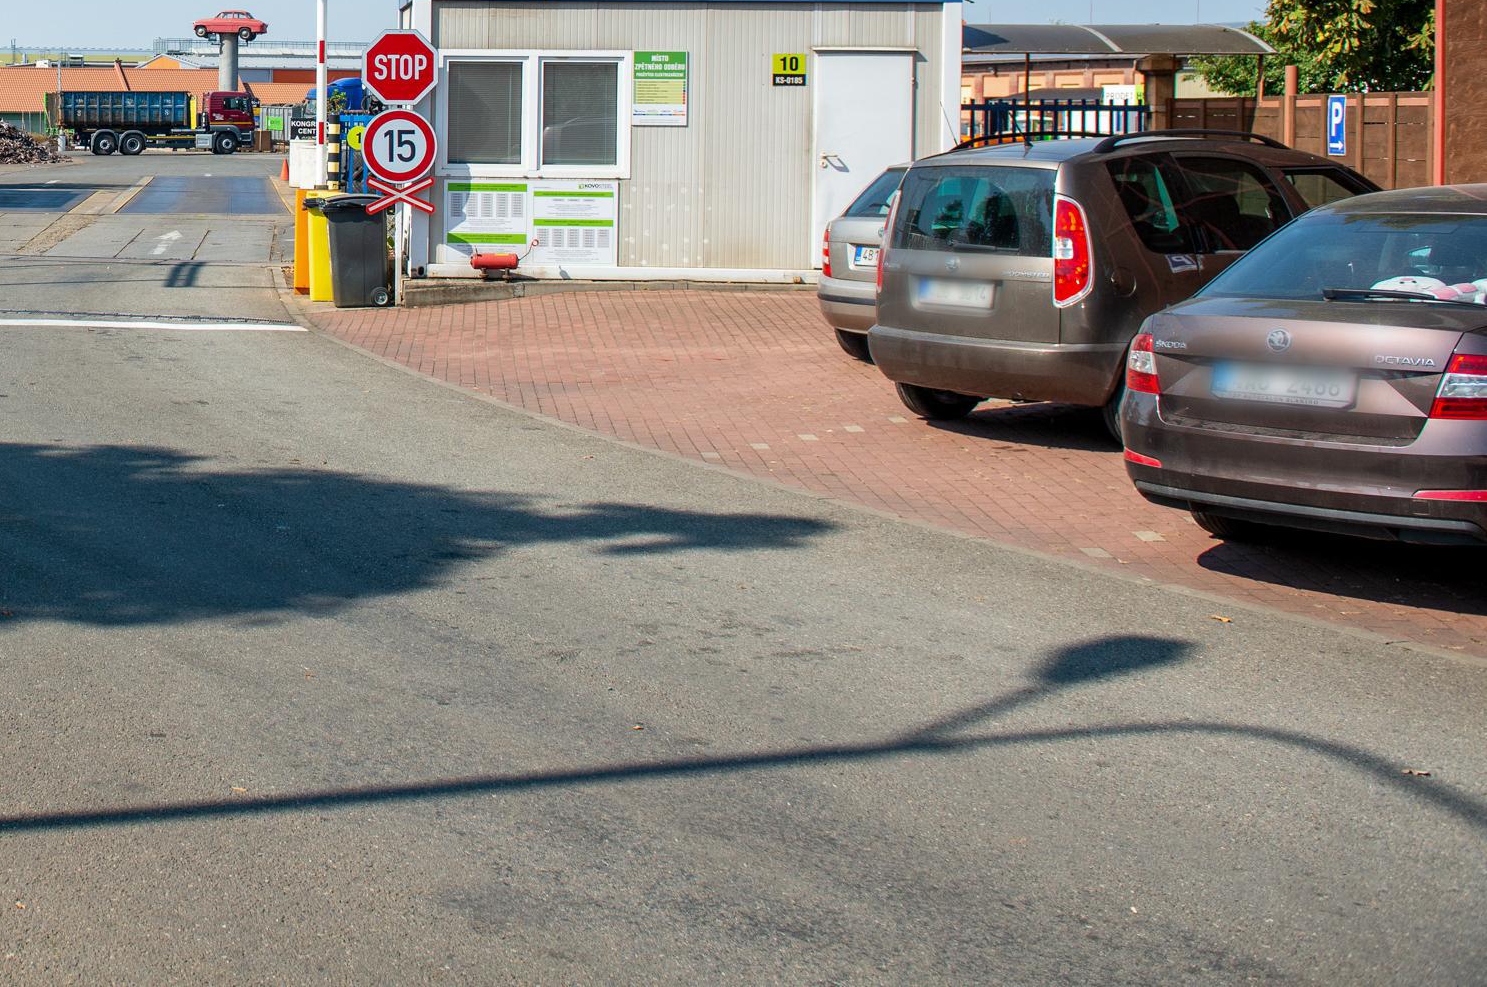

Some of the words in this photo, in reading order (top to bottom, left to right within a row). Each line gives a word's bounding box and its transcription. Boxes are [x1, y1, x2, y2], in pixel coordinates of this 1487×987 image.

[374, 54, 427, 81] STOP
[780, 56, 799, 72] 10
[1331, 101, 1344, 137] P
[383, 129, 416, 163] 15
[1155, 340, 1187, 349] ŠKODA
[1375, 355, 1436, 368] OCTAVIA
